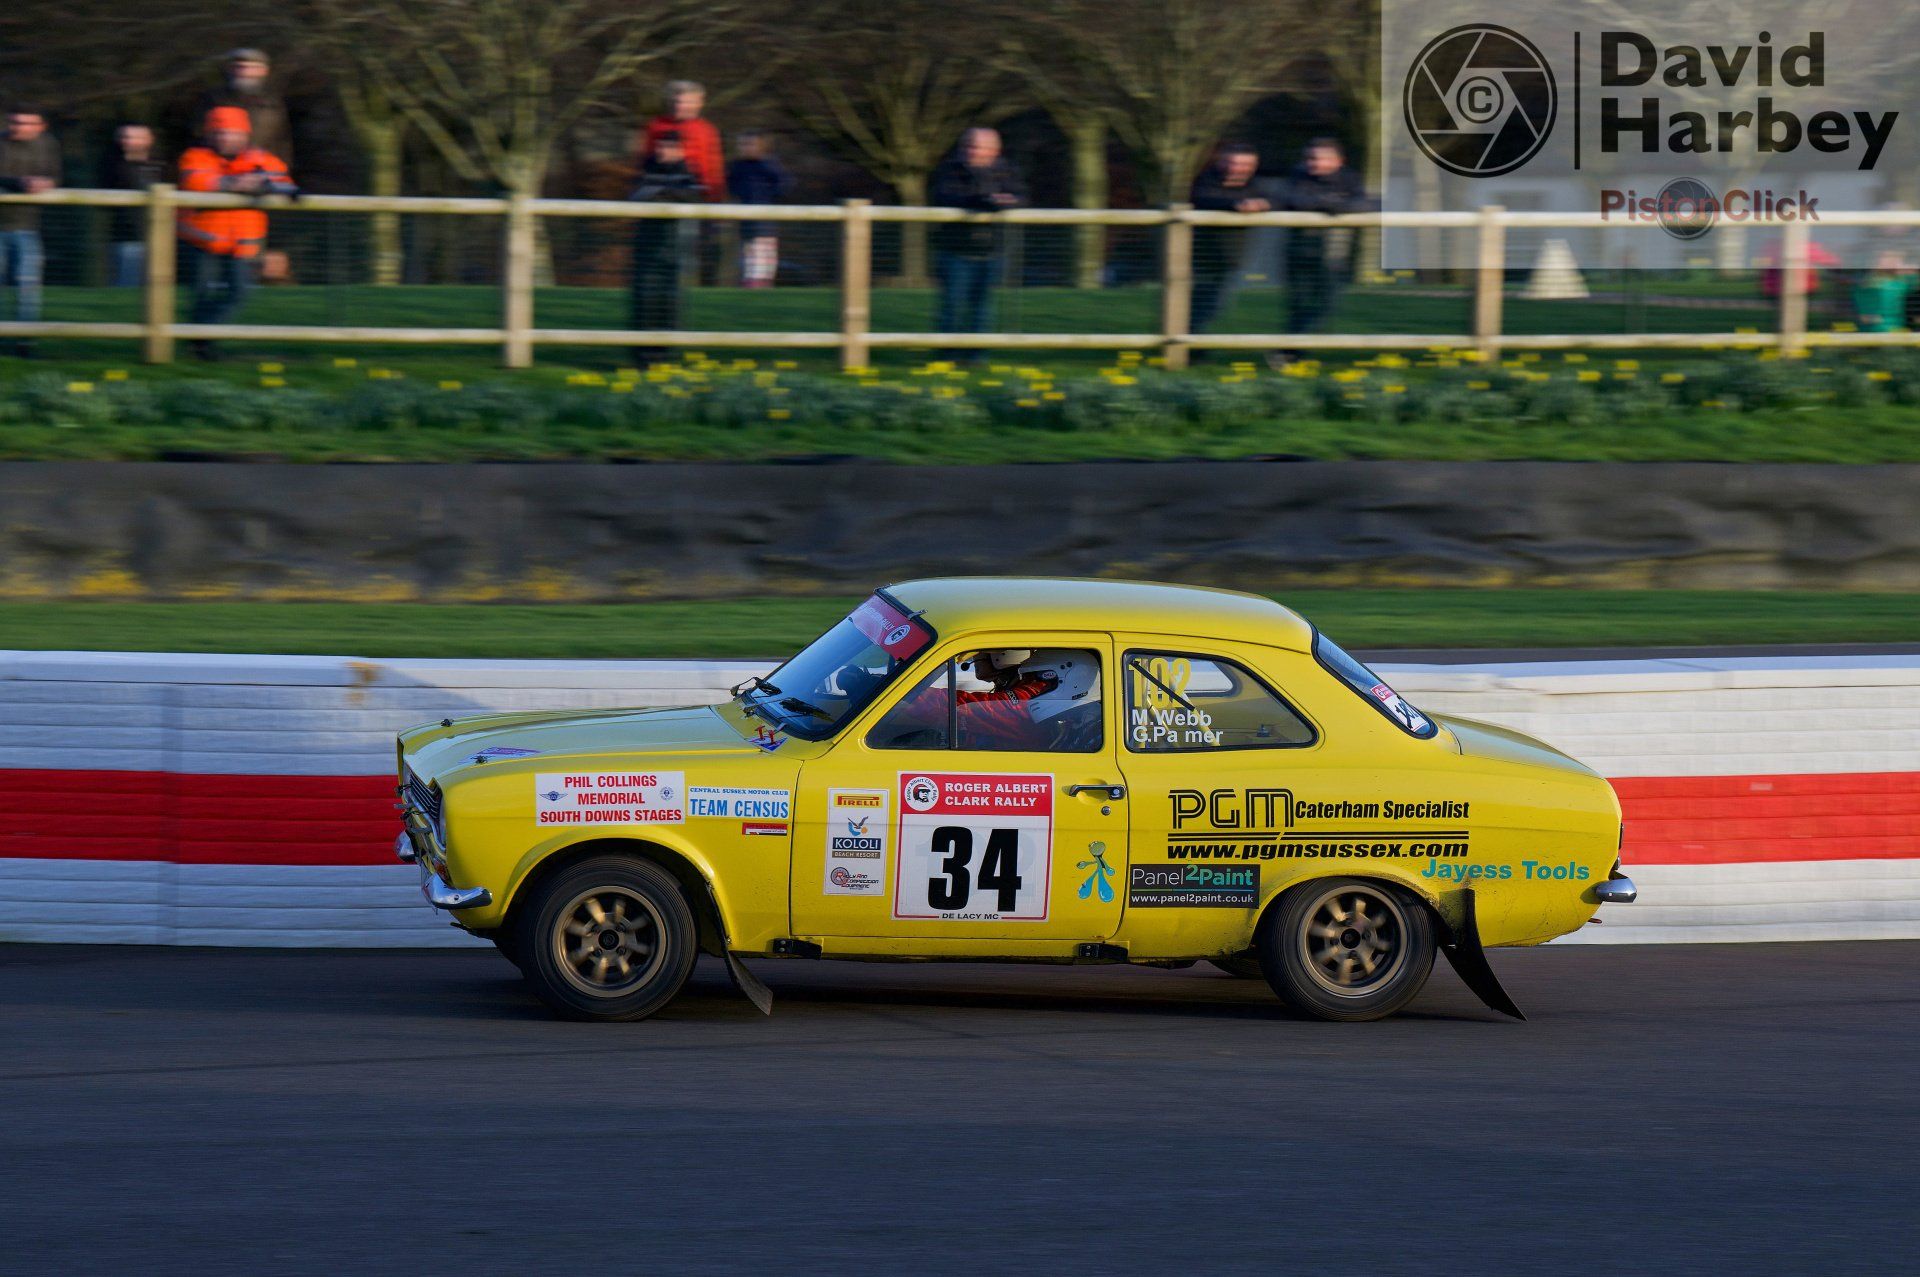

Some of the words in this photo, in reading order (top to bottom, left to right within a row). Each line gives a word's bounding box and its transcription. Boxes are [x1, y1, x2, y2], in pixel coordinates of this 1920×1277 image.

[1132, 709, 1212, 726] M.Webb
[564, 776, 593, 788] PHIL
[597, 775, 657, 787] COLLINGS
[945, 783, 991, 793] ROGER
[995, 783, 1048, 793] ALBERT
[578, 793, 645, 805] MEMORIAL
[837, 796, 880, 806] PIRELLI
[945, 796, 990, 806] CLARK
[994, 796, 1037, 807] RALLY
[690, 798, 728, 815] TEAM
[734, 800, 789, 818] CENSUS
[1168, 789, 1294, 829] PGM
[1295, 801, 1380, 818] Caterham
[1383, 800, 1469, 820] Specialist
[540, 811, 581, 823] SOUTH
[585, 810, 630, 822] DOWNS
[635, 809, 682, 821] STAGES
[835, 838, 878, 849] KOLOLI
[1167, 843, 1468, 860] www.pgmsussex.com
[927, 826, 1022, 912] 34
[1132, 865, 1253, 885] Panel2Paint
[1421, 858, 1512, 884] Jayess
[1521, 860, 1590, 880] Tools
[1131, 893, 1254, 904] www.panel2paint.co.uk
